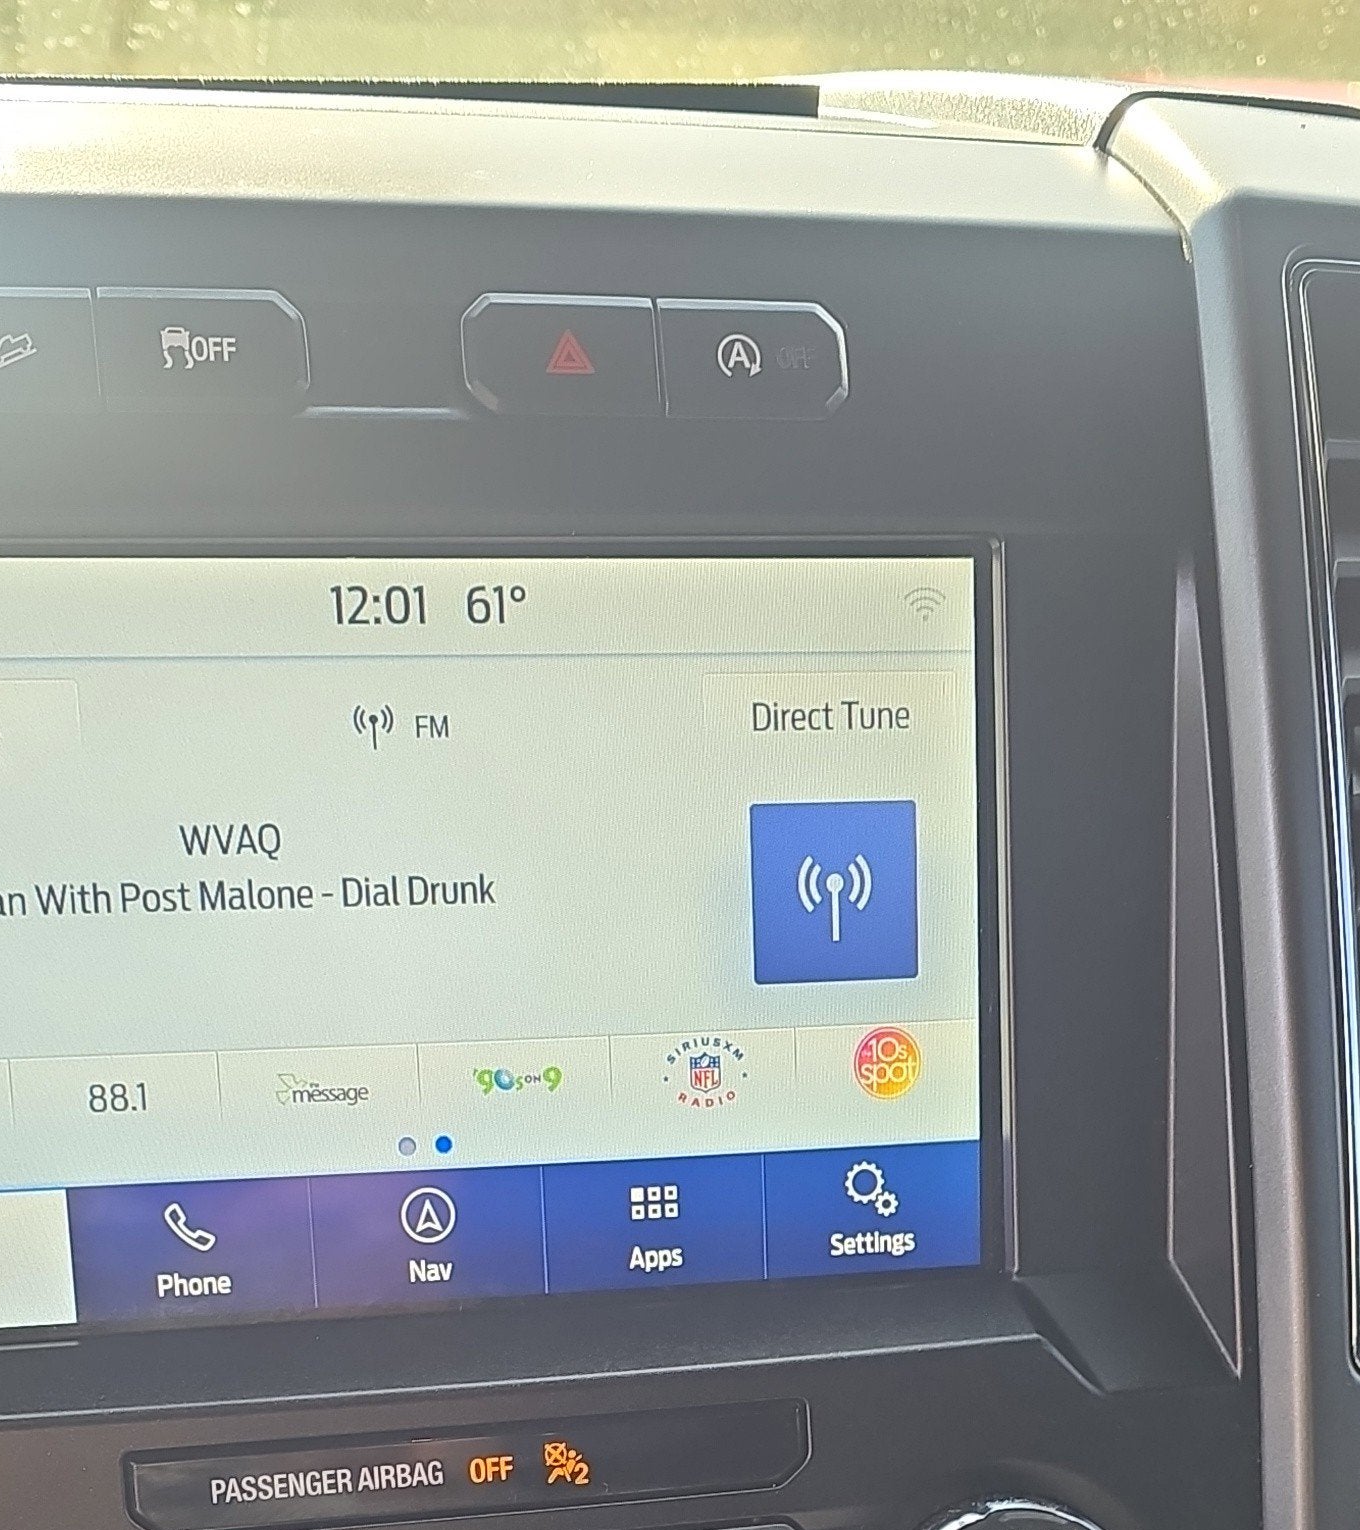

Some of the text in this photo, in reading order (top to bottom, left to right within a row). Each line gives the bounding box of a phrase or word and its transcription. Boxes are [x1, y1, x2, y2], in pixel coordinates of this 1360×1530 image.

[191, 336, 236, 362] OFF
[330, 585, 426, 625] 12:01
[415, 715, 450, 738] FM
[752, 701, 910, 731] Direct Tune
[179, 824, 282, 861] WVAQ
[35, 882, 115, 917] With
[121, 880, 191, 914] Post
[198, 878, 314, 913] Malone
[341, 877, 399, 908] Dial
[408, 873, 496, 906] Drunk
[666, 1037, 744, 1065] SIRIUSXM
[694, 1069, 719, 1089] NFL
[860, 1056, 917, 1092] spot
[88, 1082, 148, 1113] 88.1
[678, 1091, 736, 1108] RADIO
[830, 1231, 916, 1257] Settings
[409, 1260, 453, 1283] Nav
[630, 1247, 683, 1273] Apps
[157, 1274, 233, 1298] Phone
[210, 1456, 513, 1504] PASSENGER AIRBAG OFF
